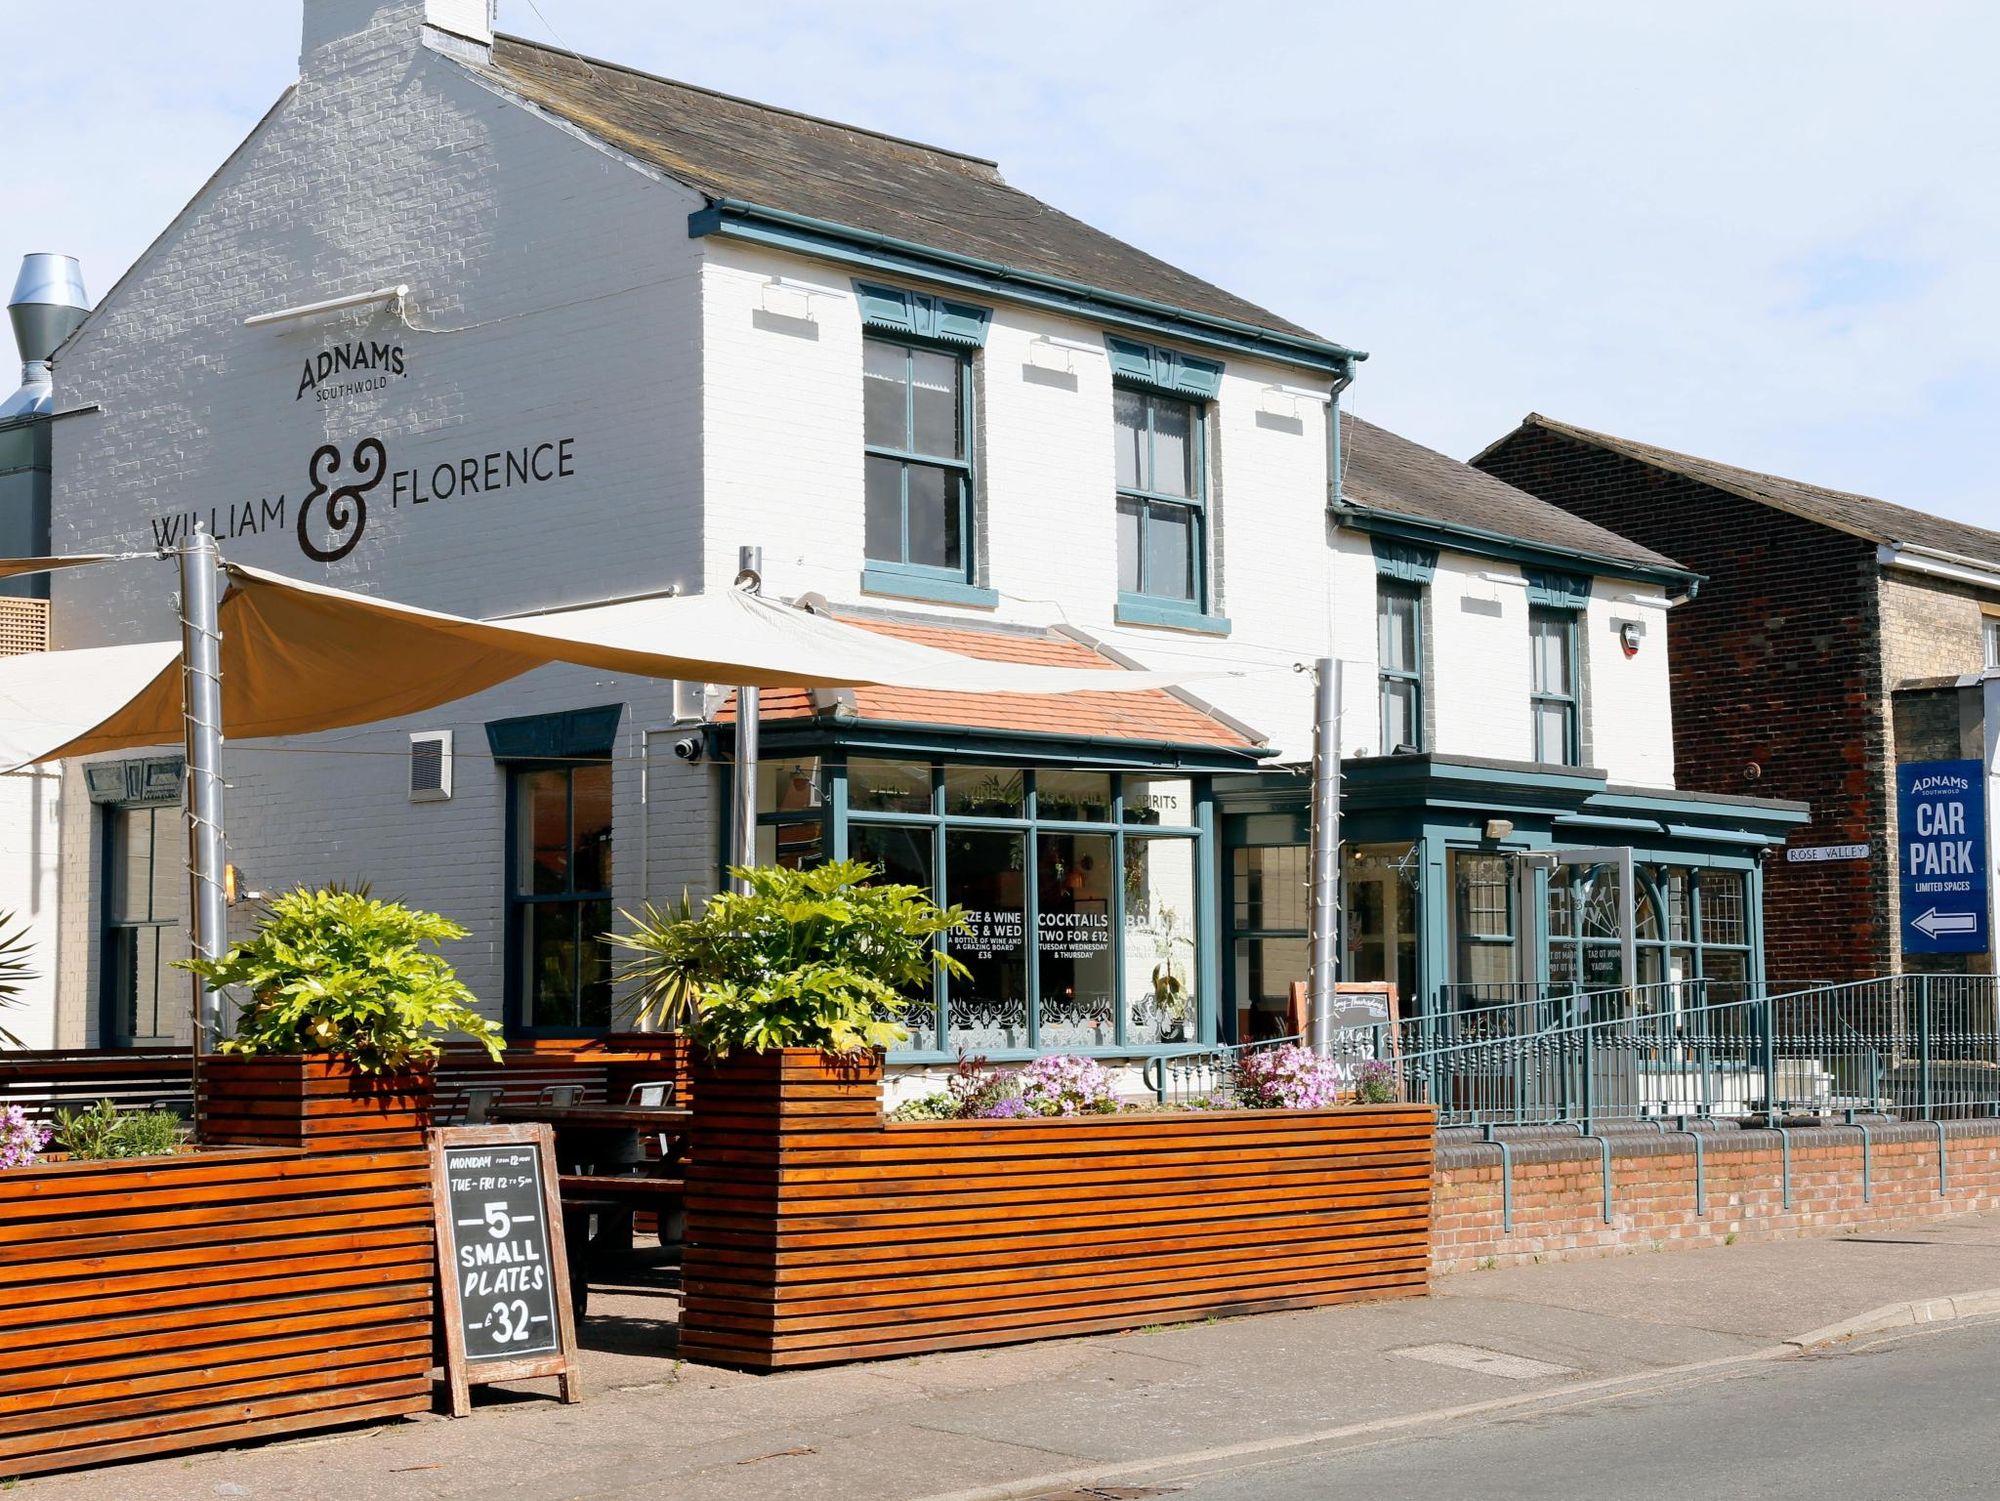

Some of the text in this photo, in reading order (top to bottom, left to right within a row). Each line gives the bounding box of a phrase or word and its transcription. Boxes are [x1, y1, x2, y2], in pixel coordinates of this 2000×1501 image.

[316, 376, 387, 402] SOUTHWOLD
[297, 437, 387, 562] &
[392, 438, 574, 508] FLORENCE
[1912, 776, 1969, 794] ADNAMS
[1922, 788, 1960, 796] SOUTHWOLD
[1917, 802, 1965, 836] CAR
[1791, 846, 1865, 860] ROSE VALLEY
[1910, 841, 1974, 875] PARK
[1915, 881, 1970, 893] LIMITED SPACES
[984, 911, 991, 922] &
[993, 912, 1021, 923] WINE
[1038, 913, 1108, 926] COCKTAILS
[983, 925, 991, 936] &
[994, 925, 1021, 937] WED
[1038, 930, 1108, 942] TWO FOR £12
[1069, 943, 1108, 951] WEDNESDAY
[978, 951, 992, 959] £36
[1054, 951, 1094, 959] & THURSDAY
[449, 1156, 492, 1170] MONDAY
[497, 1177, 508, 1189] 12
[460, 1240, 540, 1267] SMALL
[464, 1265, 545, 1298] PLATES
